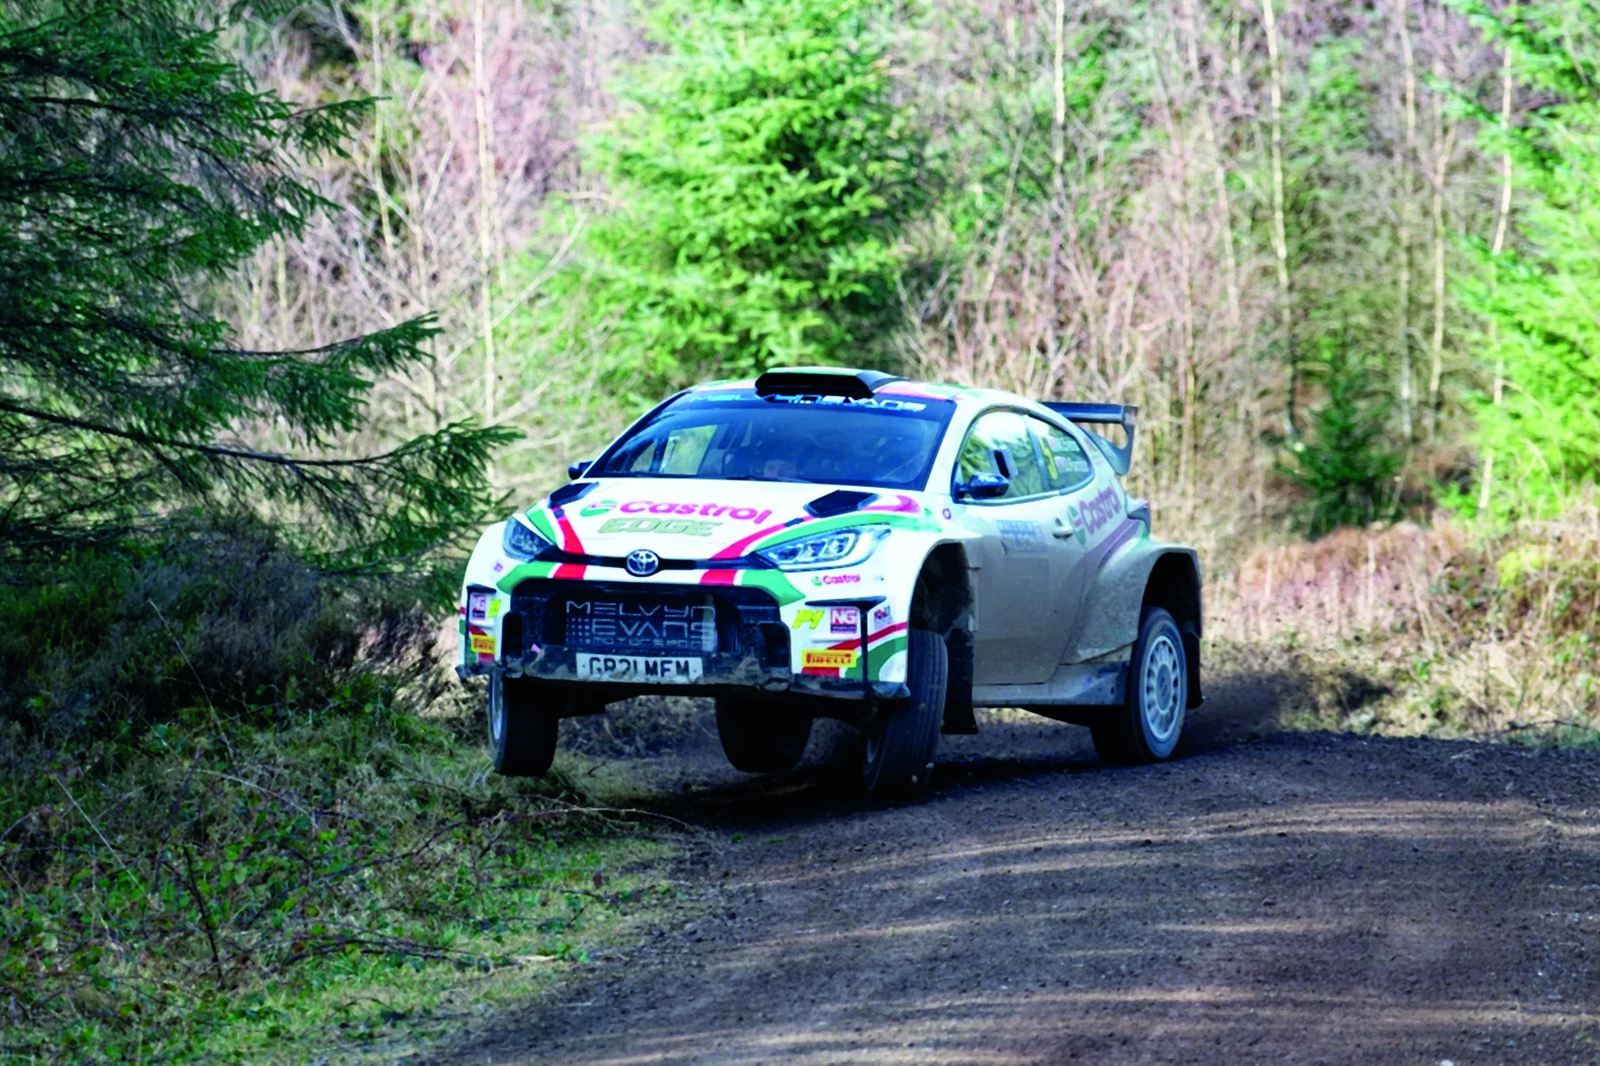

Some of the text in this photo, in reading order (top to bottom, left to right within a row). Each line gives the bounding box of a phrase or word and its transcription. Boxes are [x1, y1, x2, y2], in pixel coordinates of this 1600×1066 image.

[620, 501, 772, 524] Castrol
[1079, 480, 1121, 534] Castrol
[597, 517, 723, 537] EDGE
[823, 574, 861, 585] Castrol
[832, 609, 857, 625] NG
[591, 617, 717, 638] EVANS
